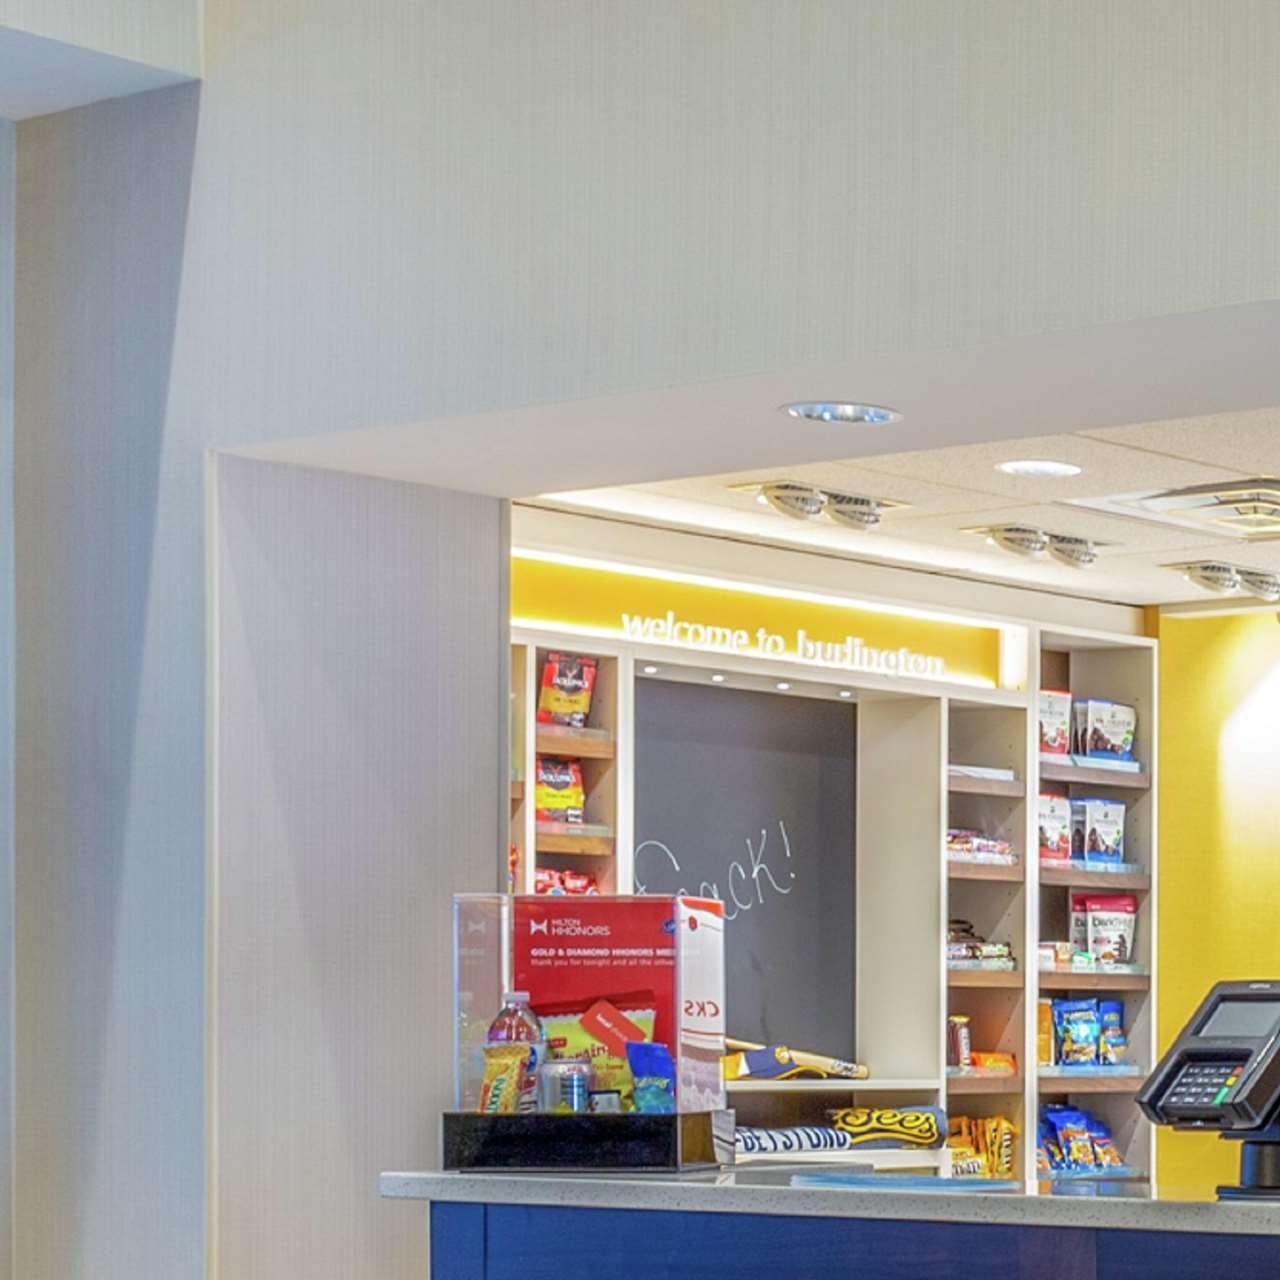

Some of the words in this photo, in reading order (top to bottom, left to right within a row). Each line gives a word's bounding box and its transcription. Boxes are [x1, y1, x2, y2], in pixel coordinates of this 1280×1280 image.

[621, 611, 748, 647] welcome
[756, 628, 784, 655] to
[797, 630, 944, 674] burlington
[551, 918, 581, 927] HILTON
[531, 948, 555, 957] GOLD
[566, 948, 610, 957] DIAMOND
